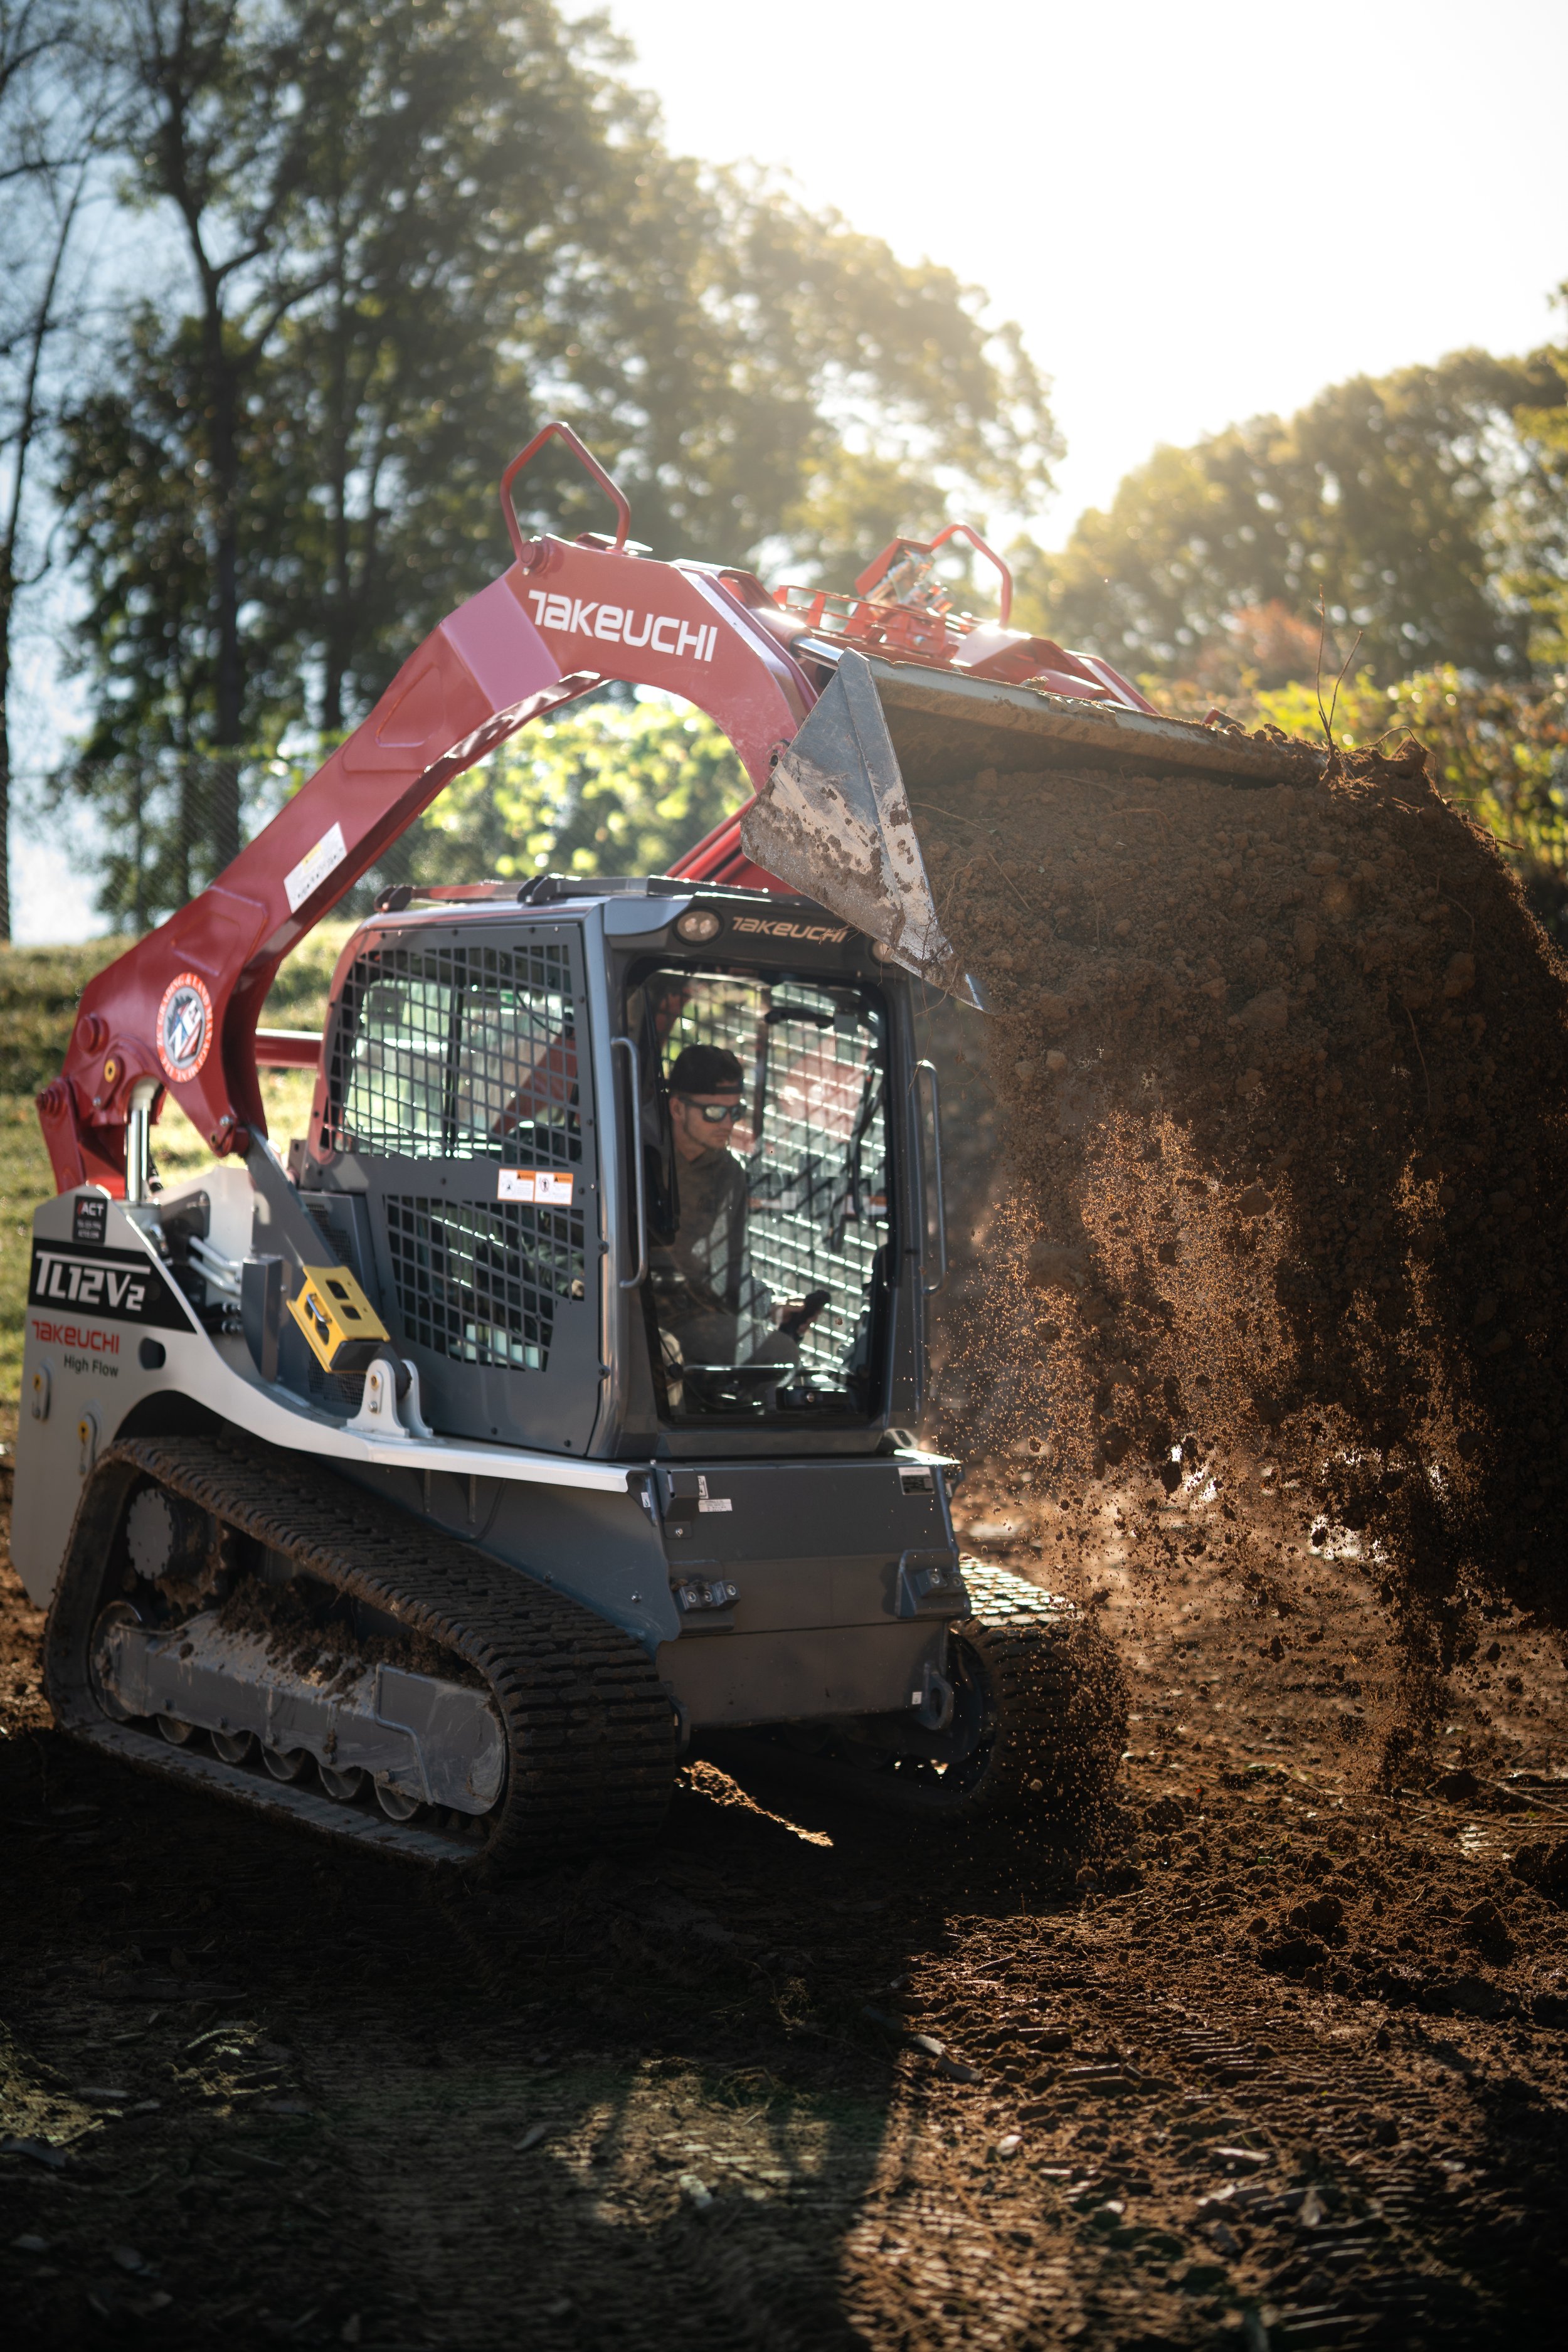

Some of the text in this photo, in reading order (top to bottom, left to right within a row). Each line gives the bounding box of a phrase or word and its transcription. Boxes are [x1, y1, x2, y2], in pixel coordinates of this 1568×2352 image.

[80, 1201, 104, 1216] ACT
[64, 1354, 119, 1378] High Flow
